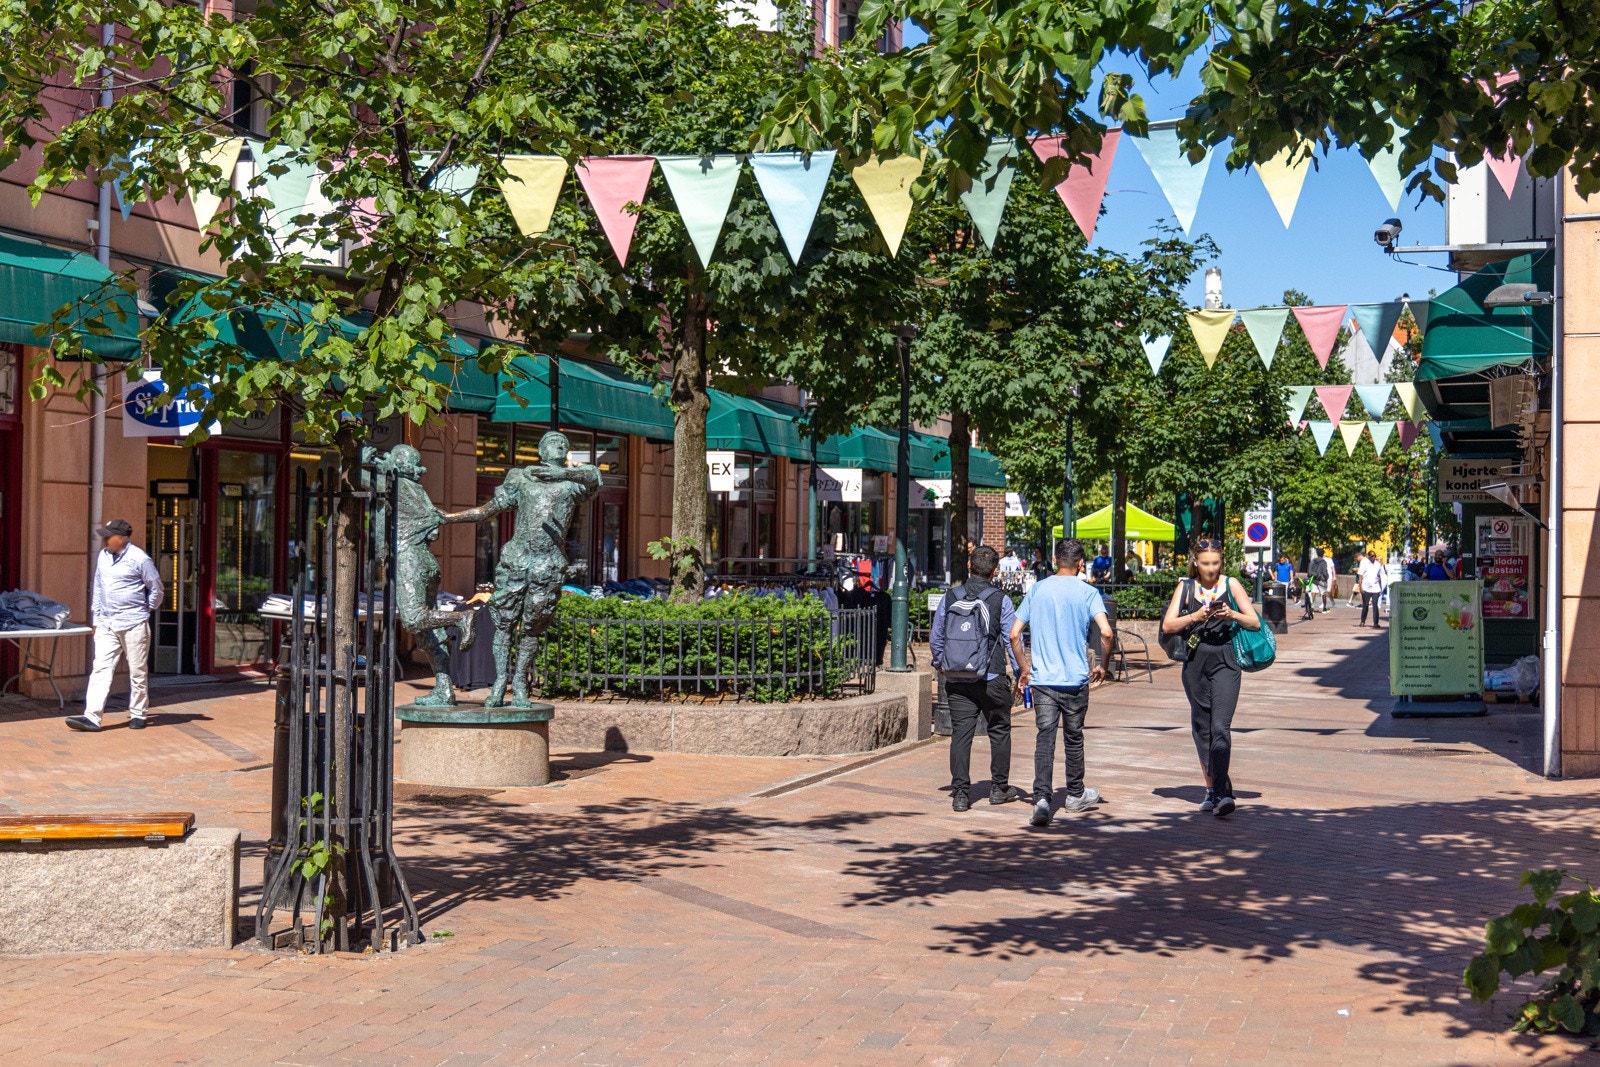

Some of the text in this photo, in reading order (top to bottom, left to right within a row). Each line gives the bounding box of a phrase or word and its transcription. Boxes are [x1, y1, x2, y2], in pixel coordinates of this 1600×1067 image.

[707, 463, 731, 475] EX
[1452, 464, 1498, 478] Hjerte
[1446, 480, 1481, 490] kondi
